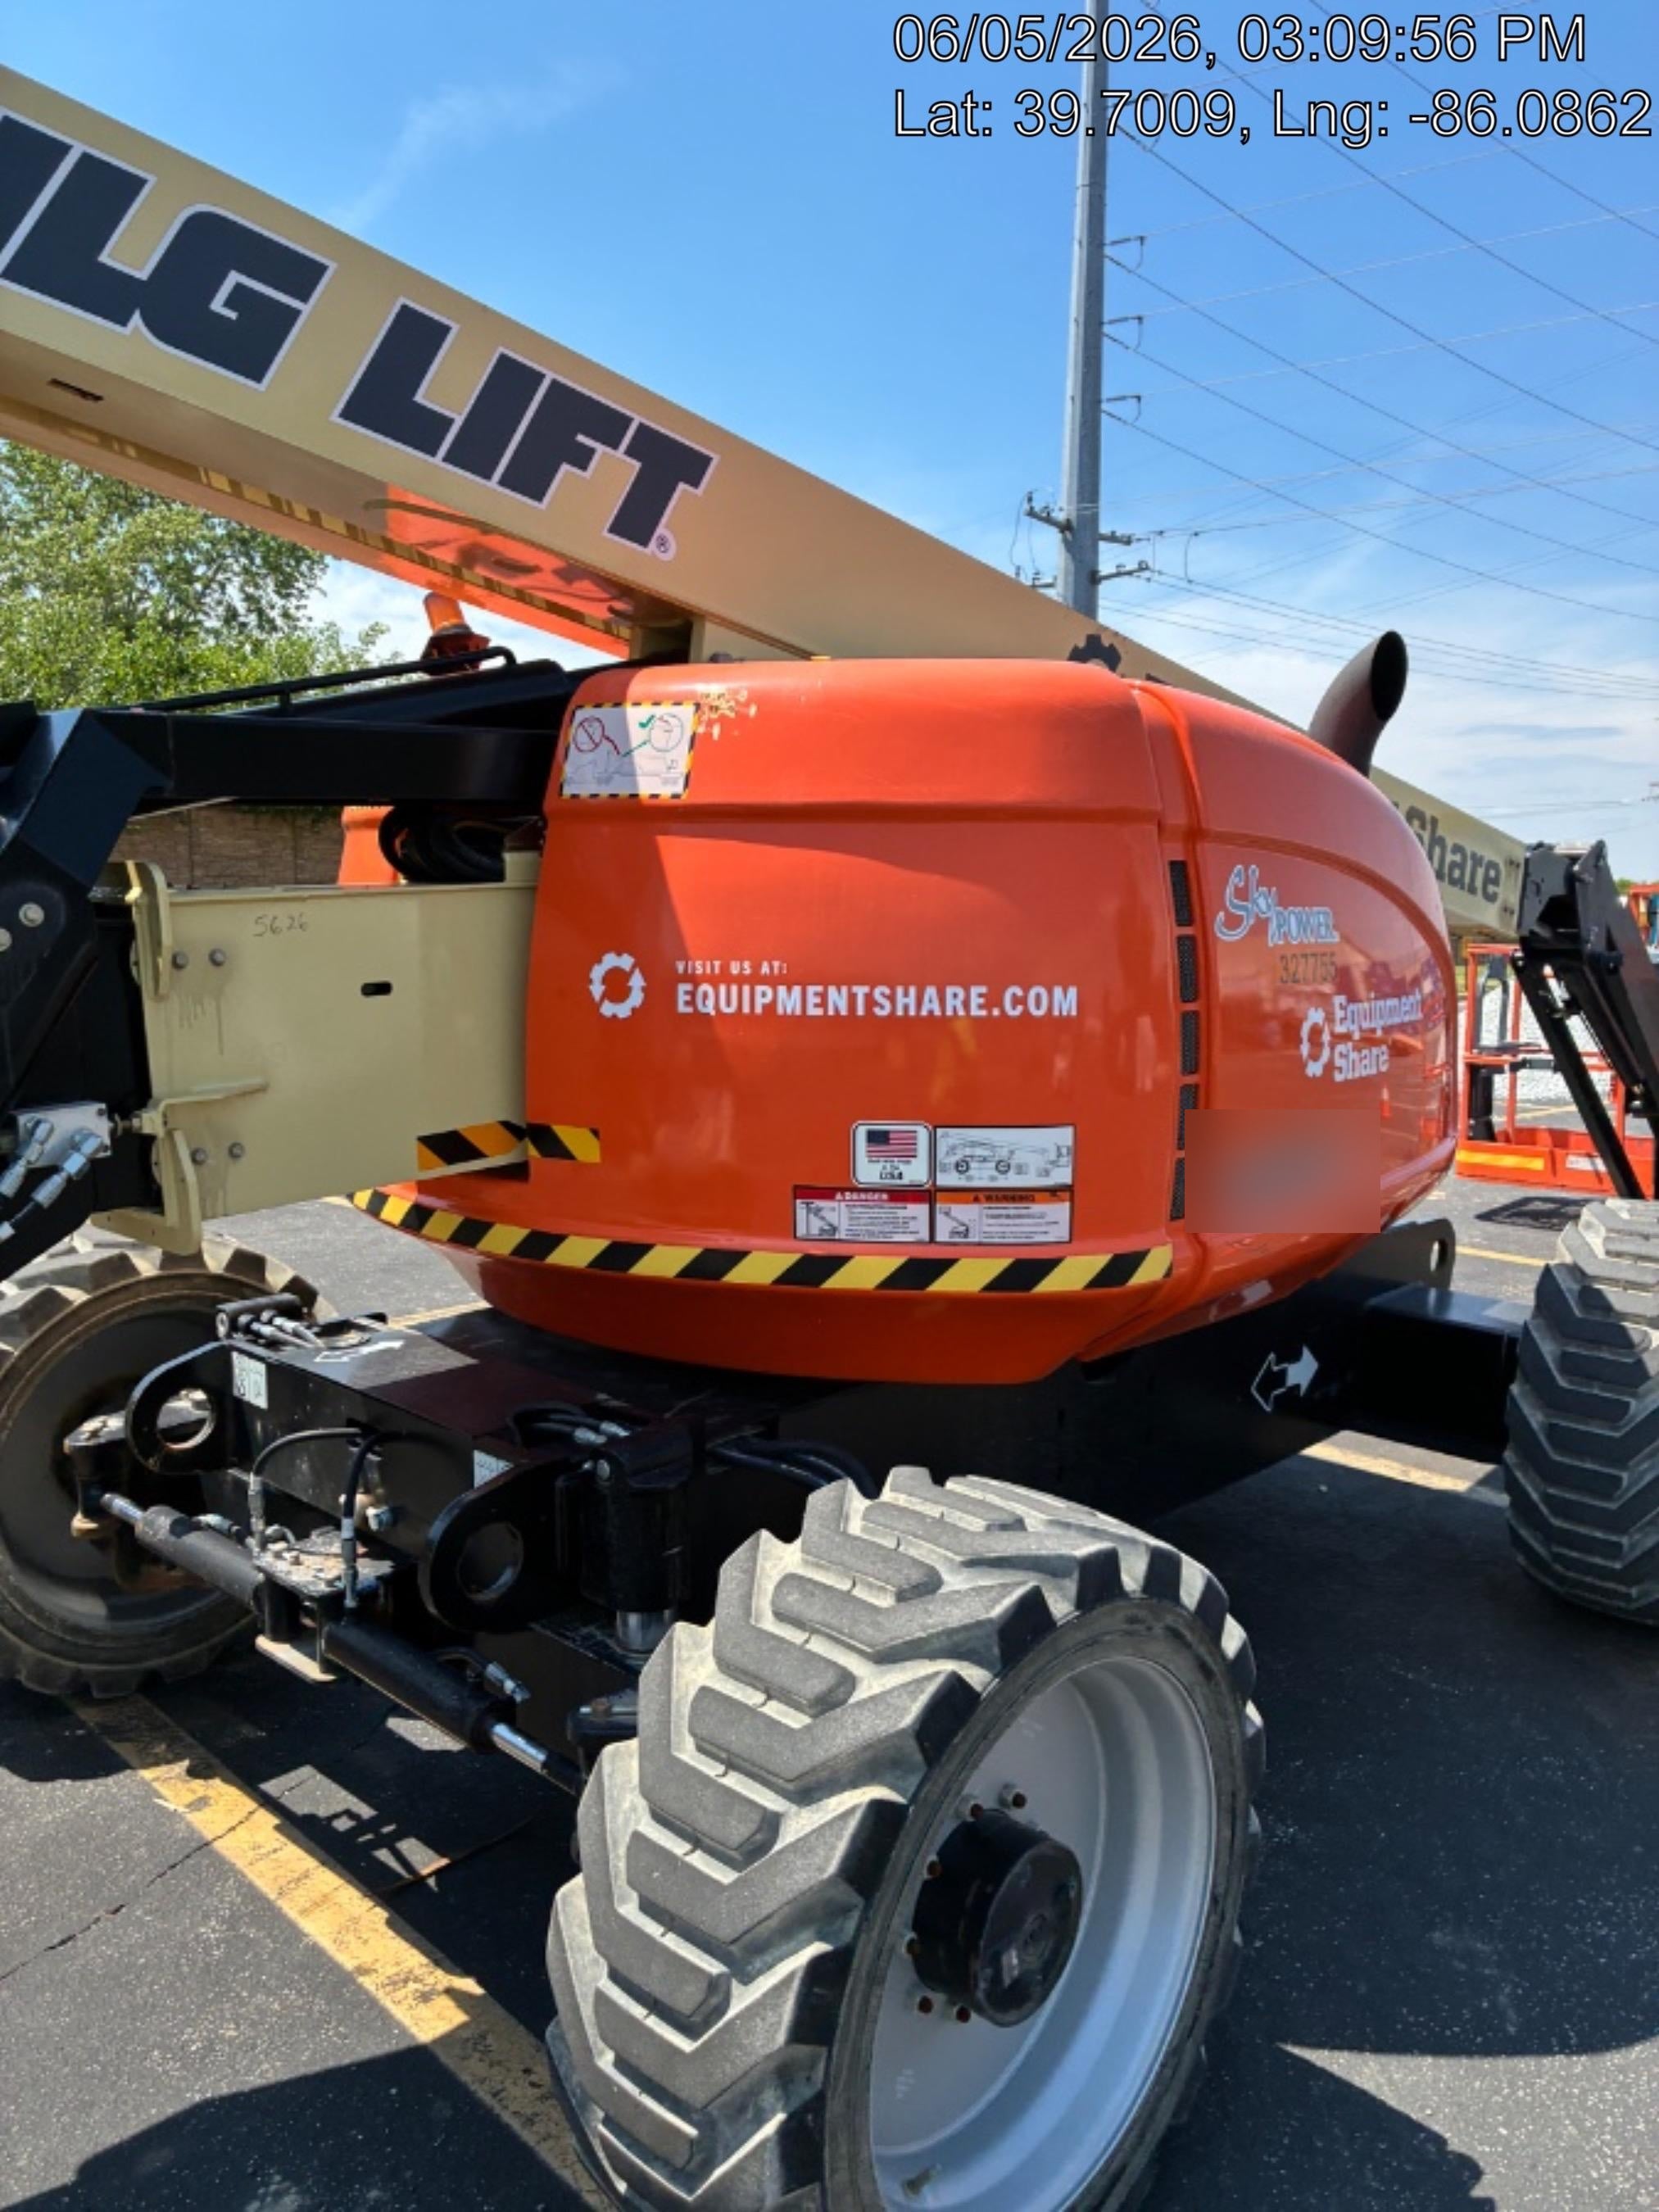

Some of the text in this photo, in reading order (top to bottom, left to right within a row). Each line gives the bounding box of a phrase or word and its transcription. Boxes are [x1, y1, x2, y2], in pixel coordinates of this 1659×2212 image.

[253, 912, 309, 937] 5626
[675, 959, 788, 977] VISIT US AT:
[676, 982, 1078, 1018] EQUIPMENTSHARE.COM
[1331, 987, 1424, 1040] Equipment
[1334, 1041, 1390, 1083] Share
